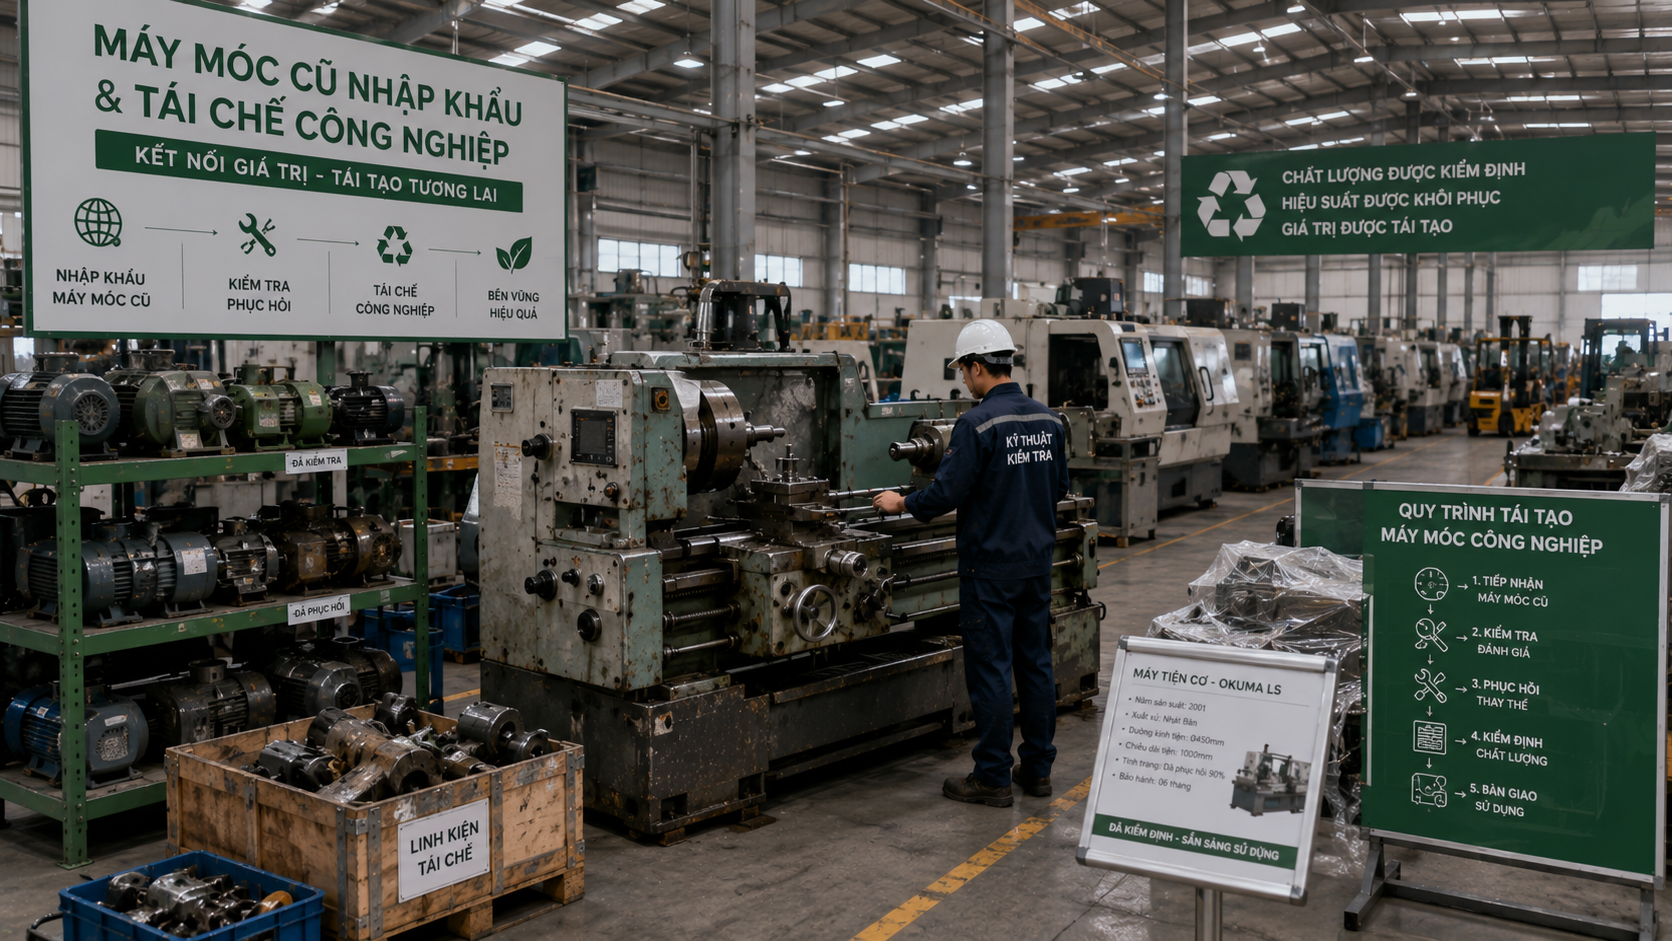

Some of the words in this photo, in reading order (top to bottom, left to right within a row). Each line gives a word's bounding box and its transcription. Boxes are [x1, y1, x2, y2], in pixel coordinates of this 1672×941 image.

[94, 23, 182, 69] MÁY
[194, 42, 280, 87] MÓC
[290, 58, 337, 96] CŨ
[348, 71, 435, 116] NHẬP
[444, 86, 522, 127] KHẨU
[94, 79, 123, 114] &
[134, 81, 196, 125] TÁI
[209, 95, 287, 137] CHẾ
[295, 106, 392, 150] CÔNG
[403, 125, 510, 170] NGHIỆP
[135, 142, 178, 167] KẾT
[187, 149, 225, 173] NỐI
[233, 156, 270, 178] GIÁ
[277, 162, 308, 187] TRỊ
[331, 167, 360, 188] TÁI
[367, 173, 402, 194] TẠO
[408, 178, 467, 200] TƯƠNG
[473, 185, 498, 203] LAI
[1282, 165, 1324, 184] CHẤT
[1328, 166, 1384, 186] LƯỢNG
[1387, 164, 1436, 183] ĐƯỢC
[1440, 158, 1480, 179] KIỂM
[1484, 162, 1526, 180] ĐỊNH
[1282, 192, 1317, 213] HIỆU
[1321, 190, 1360, 209] SUẤT
[1363, 192, 1410, 210] ĐƯỢC
[1457, 190, 1501, 208] PHỤC
[1281, 218, 1309, 236] GIÁ
[1312, 221, 1336, 239] TRỊ
[1340, 219, 1387, 238] ĐƯỢC
[1391, 216, 1415, 234] TÁI
[1420, 219, 1453, 237] TẠO
[56, 266, 100, 286] NHẬP
[264, 279, 291, 292] TRA
[373, 282, 392, 297] TÁI
[52, 288, 87, 305] MÁY
[91, 290, 127, 306] MÓC
[227, 298, 265, 314] PHỤC
[326, 456, 342, 465] TRA
[1032, 449, 1053, 462] TRA
[1398, 502, 1437, 520] QUY
[1440, 501, 1495, 522] TRÌNH
[1499, 503, 1529, 524] TÁI
[1533, 508, 1574, 529] TẠO
[1381, 523, 1419, 544] MÁY
[1423, 526, 1466, 547] MÓC
[1470, 529, 1526, 550] CÔNG
[1530, 534, 1604, 559] NGHIỆP
[1472, 575, 1481, 586] 1.
[1482, 573, 1507, 587] TIẾP
[1510, 576, 1544, 592] NHẬN
[1477, 591, 1502, 604] MÁY
[1504, 592, 1530, 605] MÓC
[307, 604, 330, 615] PHỤC
[1471, 626, 1482, 637] 2.
[1514, 630, 1539, 642] TRA
[1477, 642, 1509, 656] ĐÁNH
[1511, 645, 1531, 659] GIÁ
[1132, 666, 1159, 680] MÁY
[1161, 670, 1188, 686] TIỆN
[1190, 674, 1209, 686] CƠ
[1218, 678, 1264, 694] OKUMA
[1266, 683, 1282, 696] LS
[1471, 678, 1482, 689] 3.
[1483, 679, 1516, 694] PHỤC
[1188, 702, 1207, 712] 2001
[1476, 695, 1505, 708] THAY
[1470, 730, 1481, 741] 4.
[1513, 735, 1543, 750] ĐỊNH
[1180, 749, 1214, 761] 1000mm
[1508, 752, 1548, 767] LƯỢNG
[1157, 777, 1168, 787] 06
[1208, 769, 1226, 780] 90%
[1470, 783, 1480, 794] 5.
[1508, 788, 1538, 801] GIAO
[1493, 803, 1525, 817] DỤNG
[410, 830, 443, 855] LINH
[447, 819, 479, 843] KIỆN
[417, 854, 440, 876] TÁI
[444, 842, 473, 867] CHẾ
